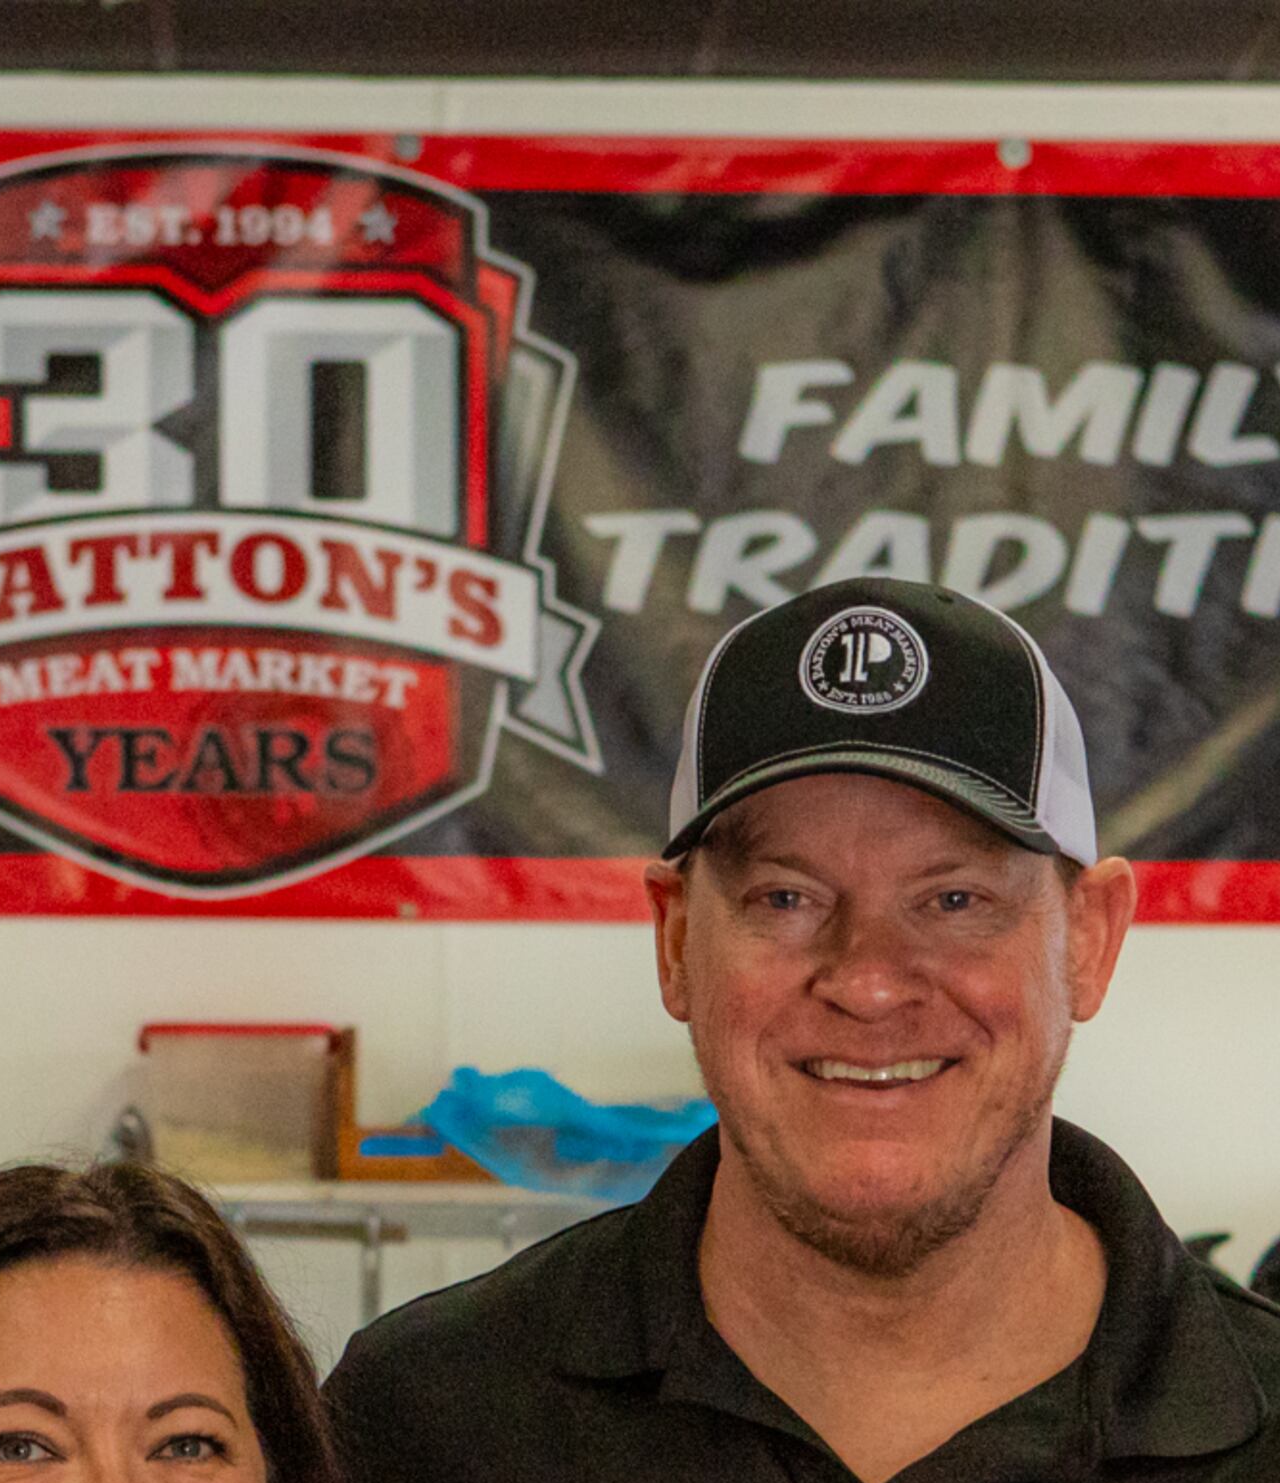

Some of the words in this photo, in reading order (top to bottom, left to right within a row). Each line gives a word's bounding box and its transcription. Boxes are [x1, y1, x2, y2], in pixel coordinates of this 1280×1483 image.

[85, 208, 201, 247] EST.
[215, 206, 335, 247] 1994
[171, 648, 419, 709] MARKET
[47, 724, 378, 793] YEARS
